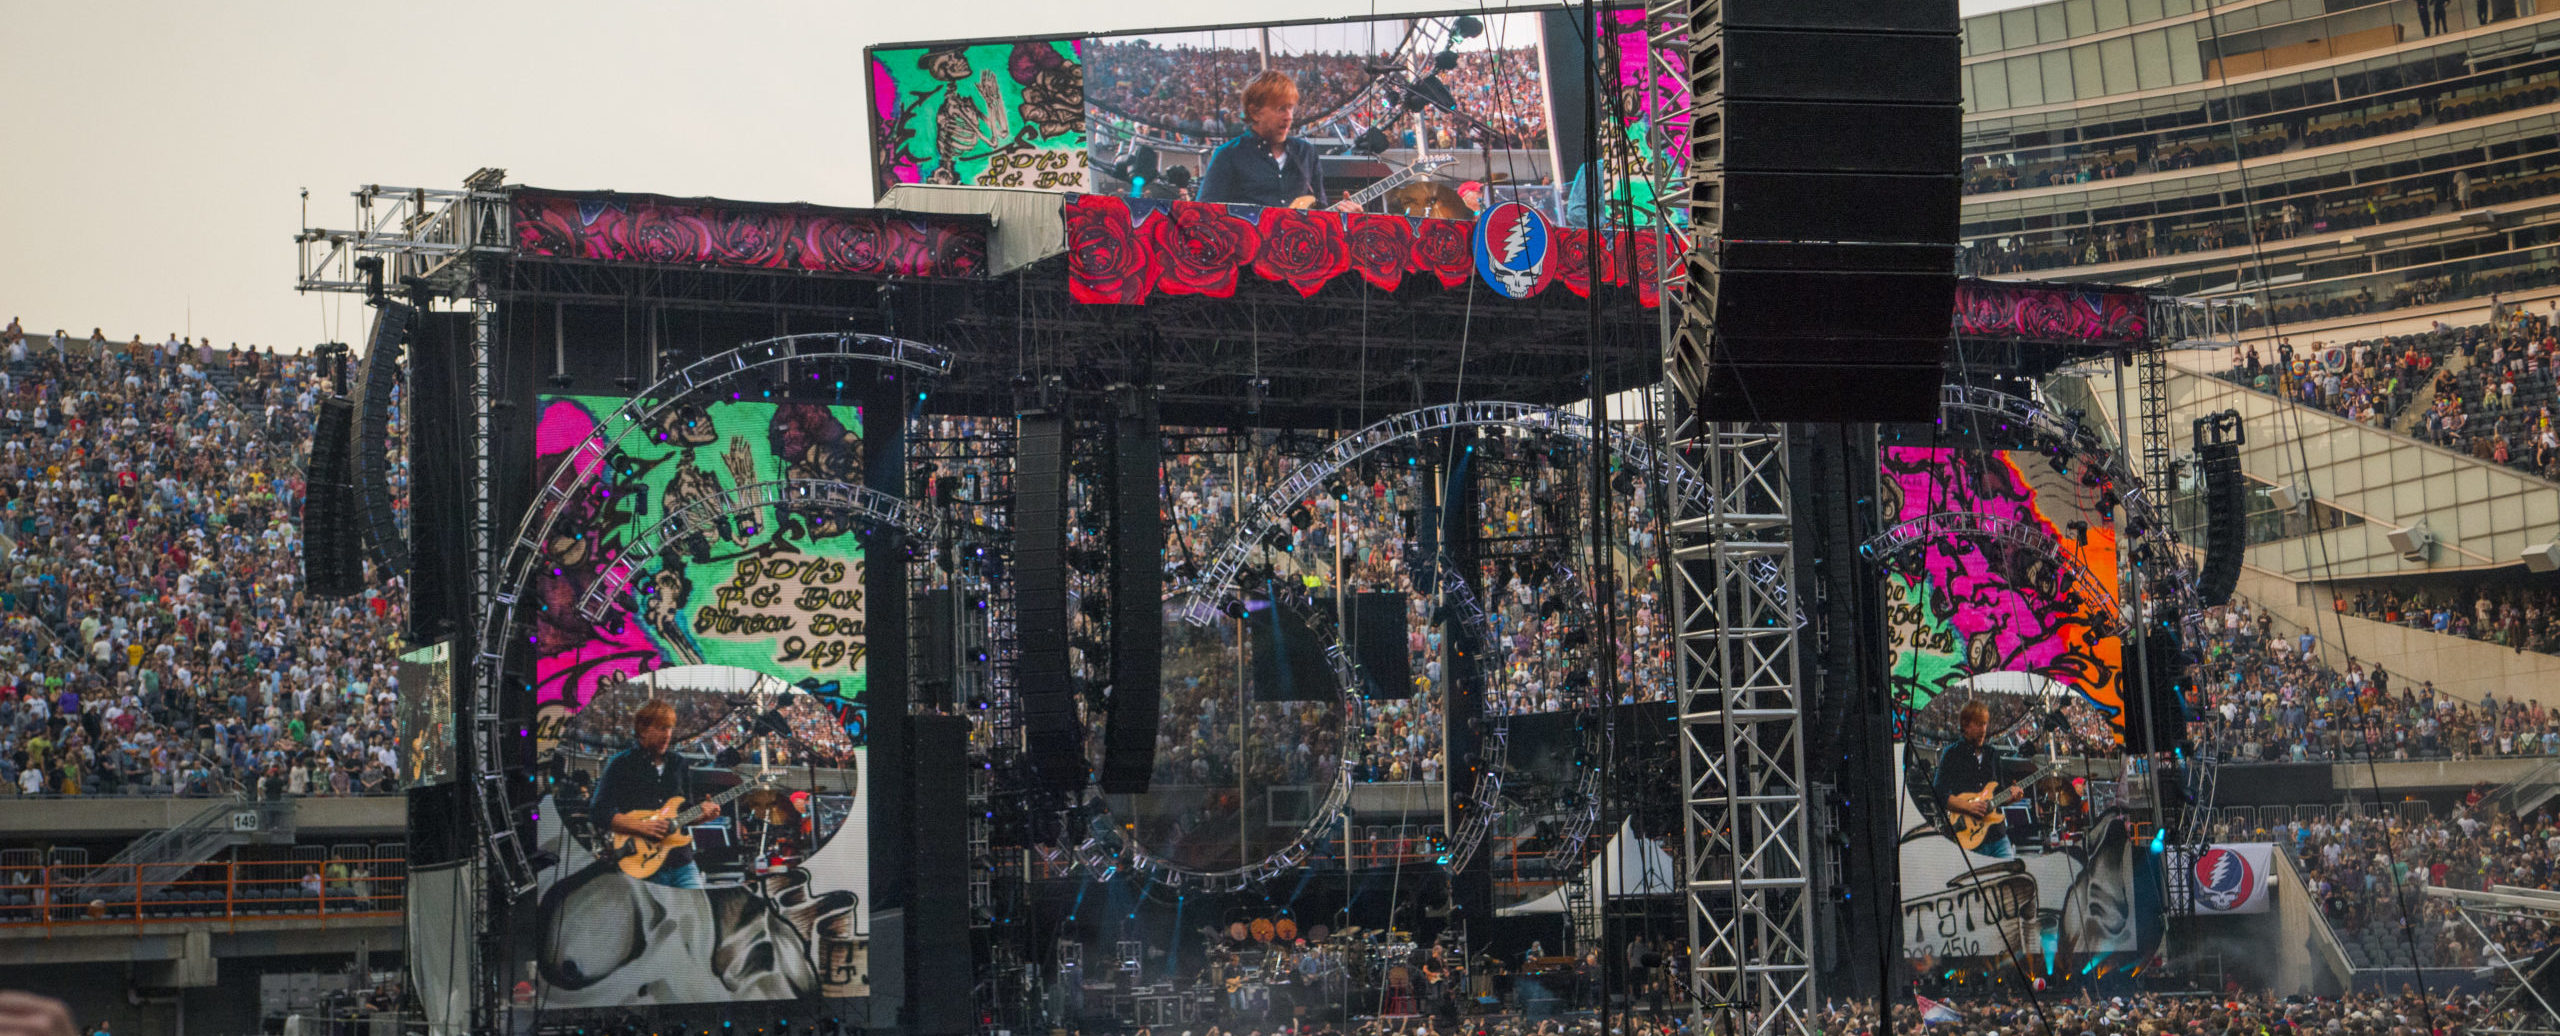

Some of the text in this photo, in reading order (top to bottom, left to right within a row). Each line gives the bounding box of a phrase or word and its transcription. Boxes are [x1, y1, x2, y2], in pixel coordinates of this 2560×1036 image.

[1033, 171, 1082, 189] Box
[794, 586, 863, 612] Box
[694, 605, 797, 635] Stinson
[235, 815, 256, 828] 149
